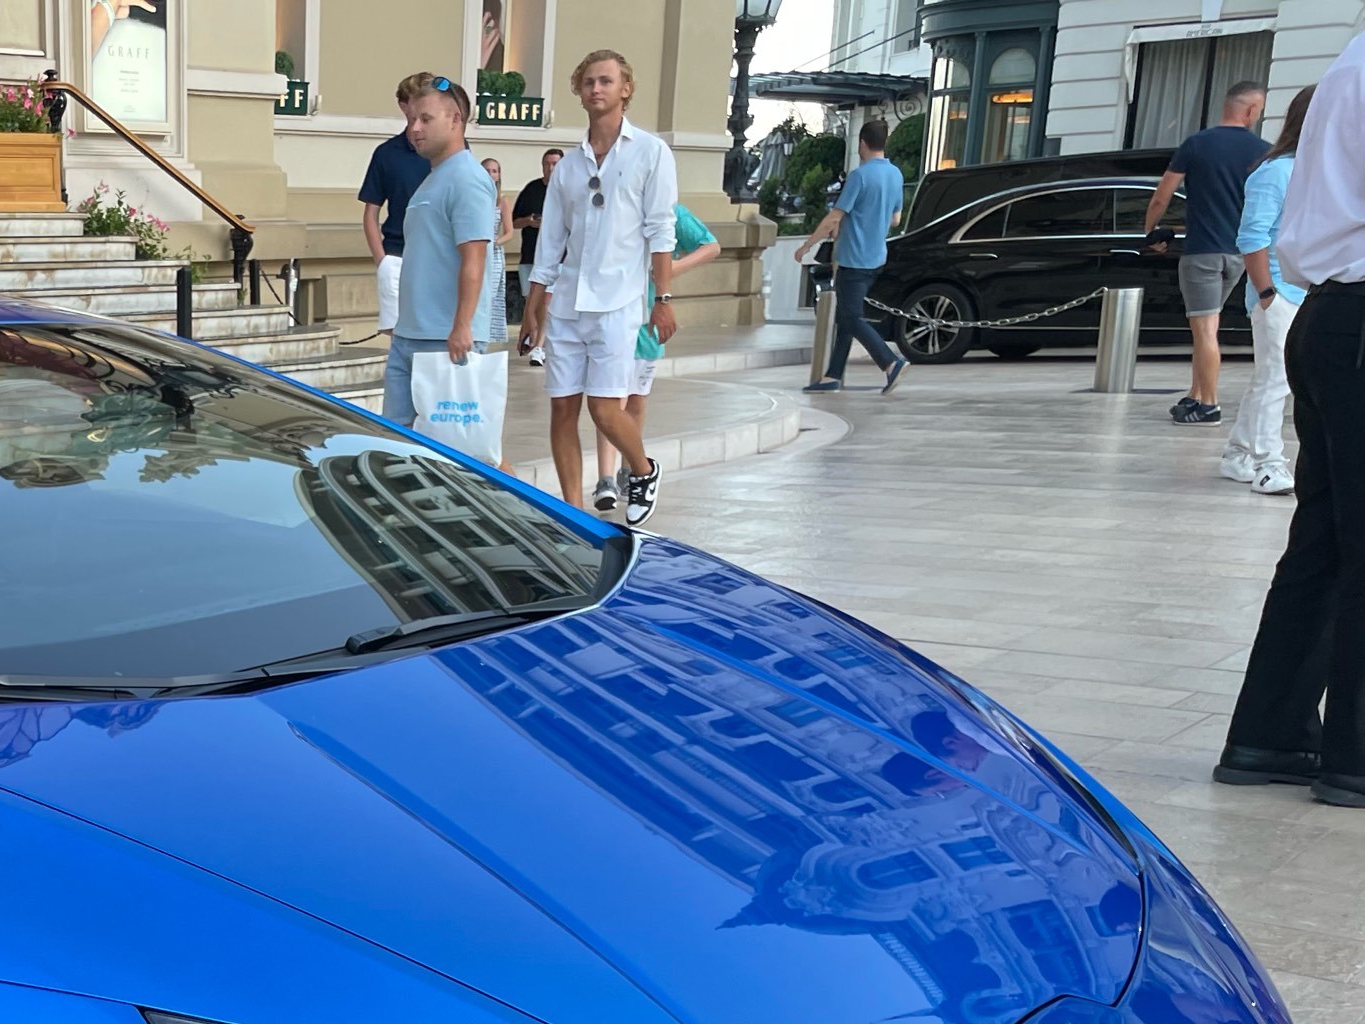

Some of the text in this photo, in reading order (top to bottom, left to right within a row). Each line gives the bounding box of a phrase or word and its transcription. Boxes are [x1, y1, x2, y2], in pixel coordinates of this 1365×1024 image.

[107, 45, 150, 59] GRAFF
[485, 102, 541, 121] GRAFF
[436, 400, 479, 412] renew
[430, 412, 484, 428] europe.
